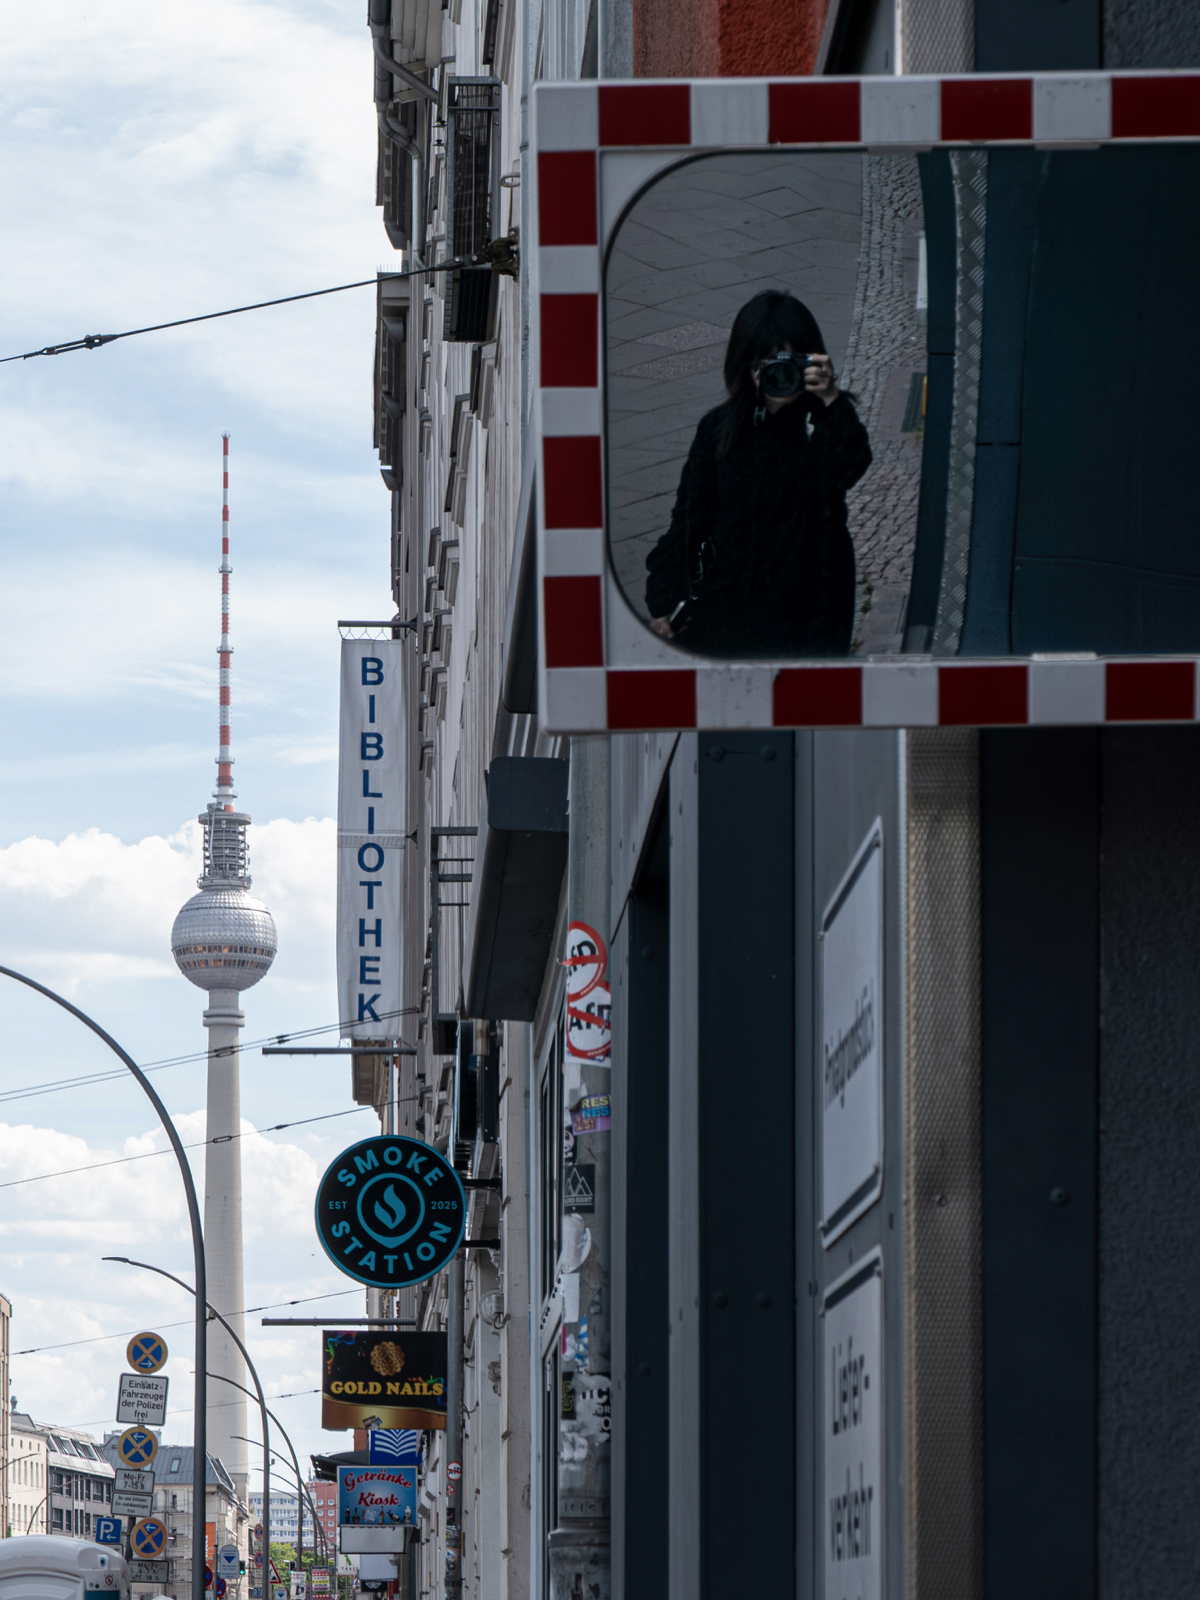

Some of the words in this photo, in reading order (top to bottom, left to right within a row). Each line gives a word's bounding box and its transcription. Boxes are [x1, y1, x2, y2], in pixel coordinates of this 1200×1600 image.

[357, 656, 385, 1023] BIBLIOTHEK
[337, 1146, 444, 1187] SMOKE
[329, 1201, 347, 1210] EST
[431, 1201, 457, 1210] 2025
[331, 1220, 452, 1274] STATION
[128, 1379, 163, 1390] Einsatz-
[330, 1381, 382, 1395] GOLD
[386, 1382, 444, 1396] NAILS
[121, 1389, 164, 1401] Fahrzeuge
[121, 1399, 135, 1408] der
[136, 1400, 163, 1410] Polizei
[134, 1410, 148, 1418] frei
[344, 1469, 413, 1491] Getränke
[357, 1491, 400, 1507] Kiosk
[100, 1521, 114, 1540] P
